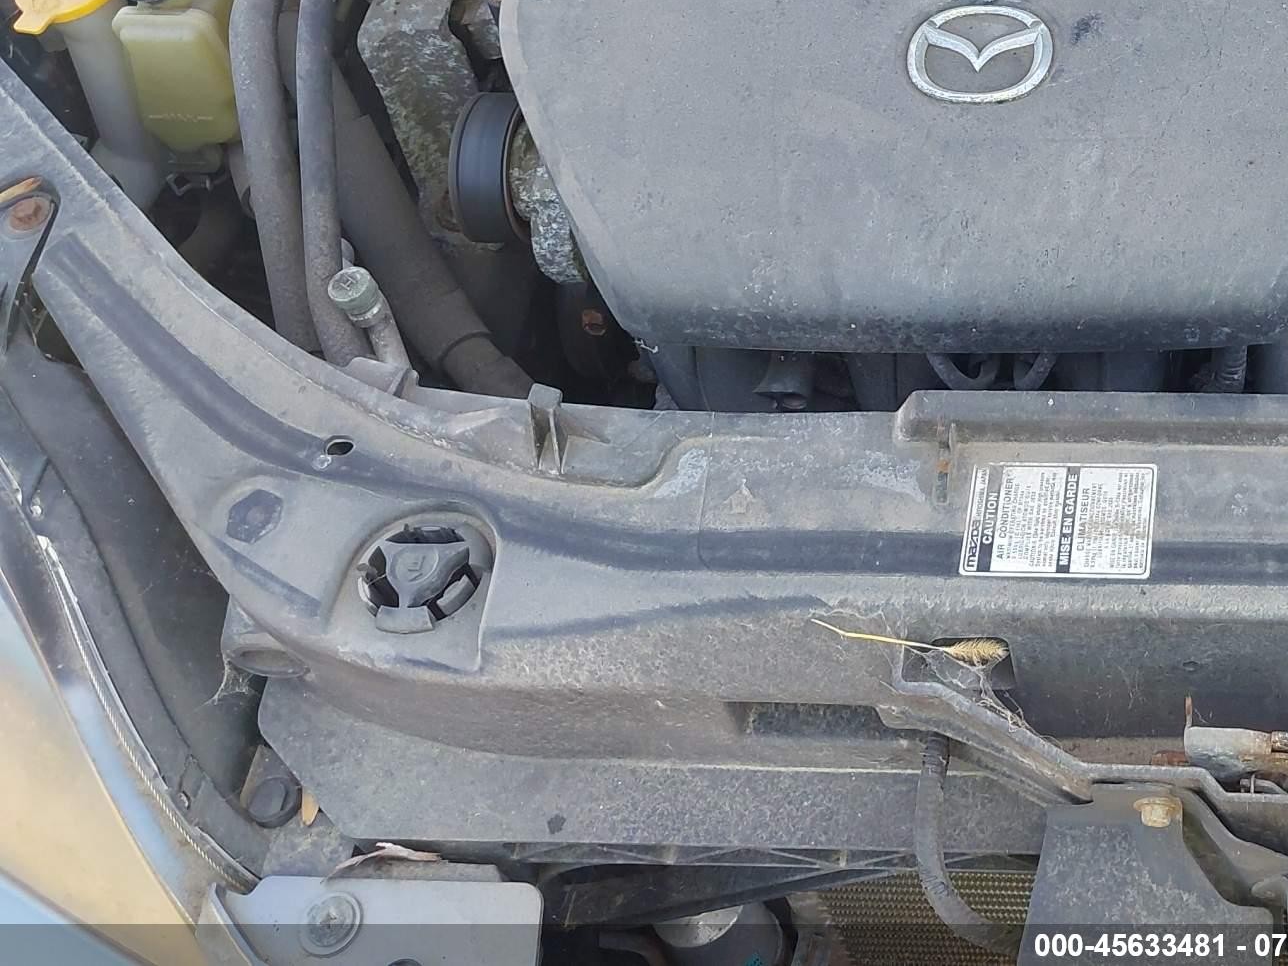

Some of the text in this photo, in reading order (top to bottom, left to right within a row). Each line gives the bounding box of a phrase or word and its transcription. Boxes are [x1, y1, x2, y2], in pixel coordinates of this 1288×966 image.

[982, 491, 999, 545] CAUTION
[996, 478, 1013, 560] AIR CONDITIONER
[1059, 473, 1078, 567] MISE EN GARDE
[1076, 487, 1091, 552] CLIMATISEUR
